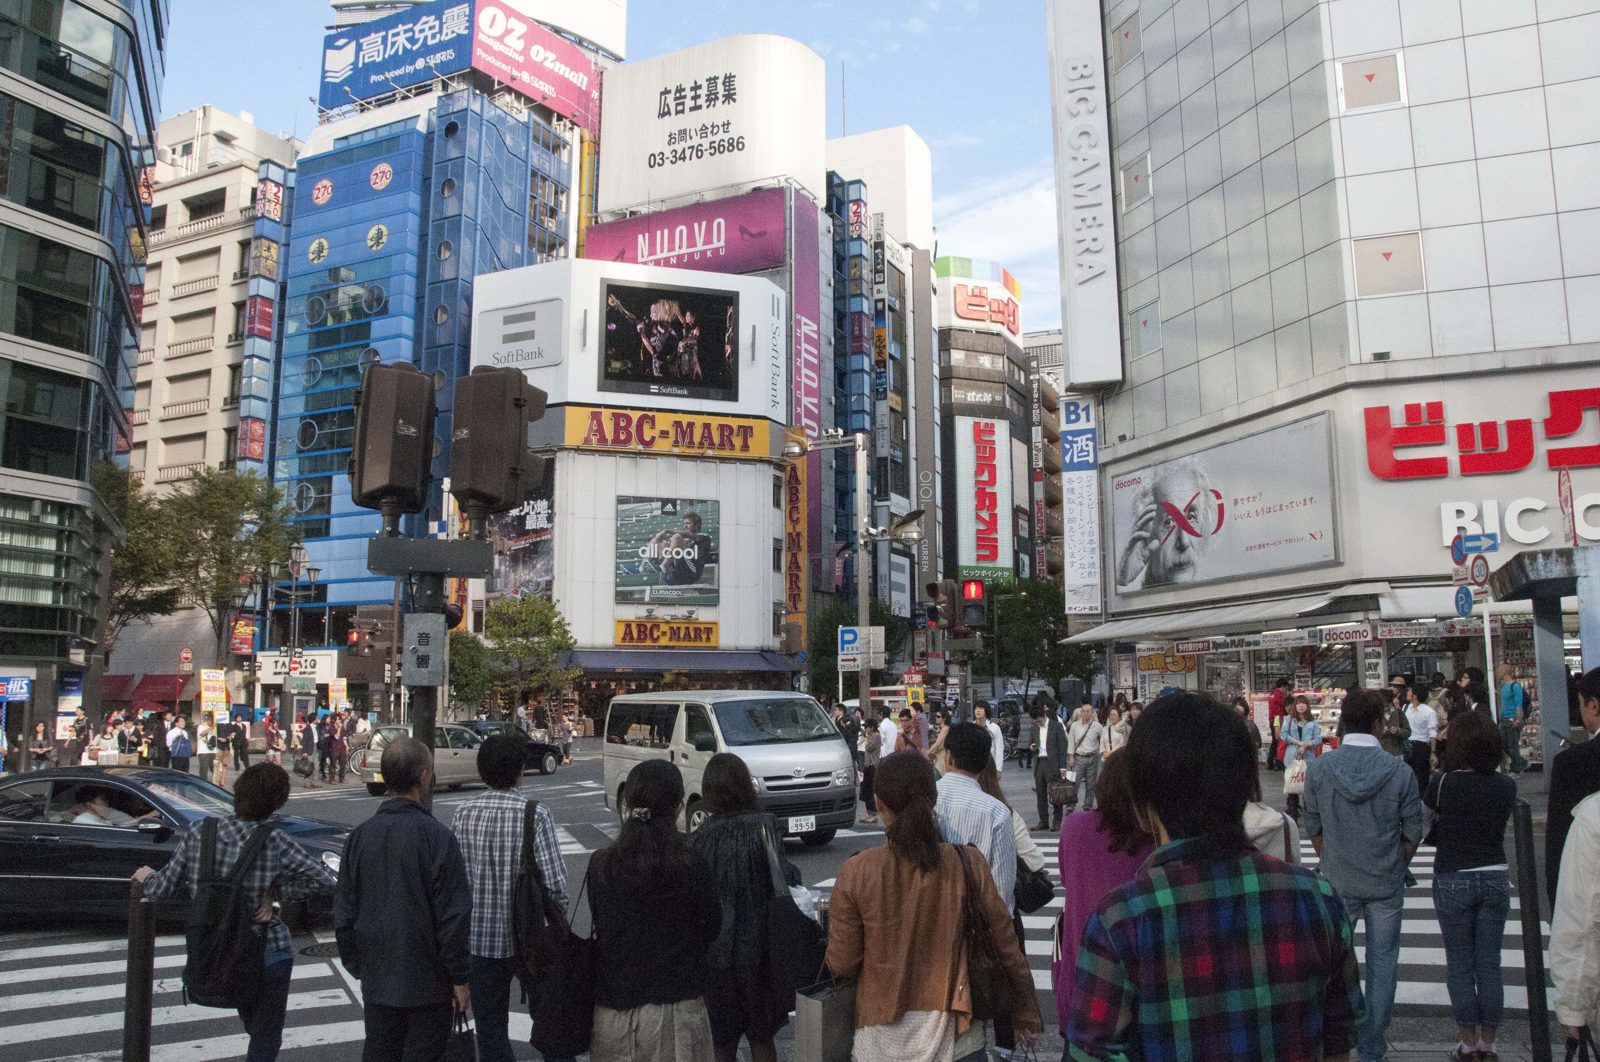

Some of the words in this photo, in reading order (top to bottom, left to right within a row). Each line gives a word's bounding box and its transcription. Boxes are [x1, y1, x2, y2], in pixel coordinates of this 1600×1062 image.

[358, 3, 470, 68] 高床免震
[478, 6, 527, 51] OZ
[476, 47, 511, 74] Produced
[477, 33, 525, 64] magazine
[370, 66, 404, 84] Produced
[1064, 56, 1097, 117] BIC
[657, 71, 737, 120] 広告主募集
[667, 119, 732, 146] お問い合わせ
[648, 135, 745, 169] 03-3476-5686
[371, 169, 391, 187] 270
[314, 183, 333, 201] 270
[1068, 123, 1106, 286] CAMERA
[638, 217, 726, 263] NUOVO
[954, 284, 1019, 335] ビック
[492, 346, 544, 366] SoftBank
[769, 320, 782, 409] SoftBank
[659, 386, 689, 396] SoftBank
[1064, 402, 1091, 425] B1
[583, 410, 754, 451] ABC-MART
[1064, 433, 1095, 465] 酒
[1115, 476, 1142, 490] docomo
[525, 513, 553, 530] 最高。
[1441, 498, 1551, 547] BIC
[788, 464, 802, 612] ABC-MART
[638, 545, 658, 559] all
[662, 545, 698, 560] cool
[921, 539, 929, 572] CURREN
[963, 569, 1010, 578] ビックポイントが
[1474, 563, 1485, 574] 30
[621, 623, 713, 643] ABC-MART
[840, 629, 858, 651] P
[1325, 628, 1369, 641] docomo
[415, 633, 431, 669] 音響
[794, 822, 814, 832] 99-58
